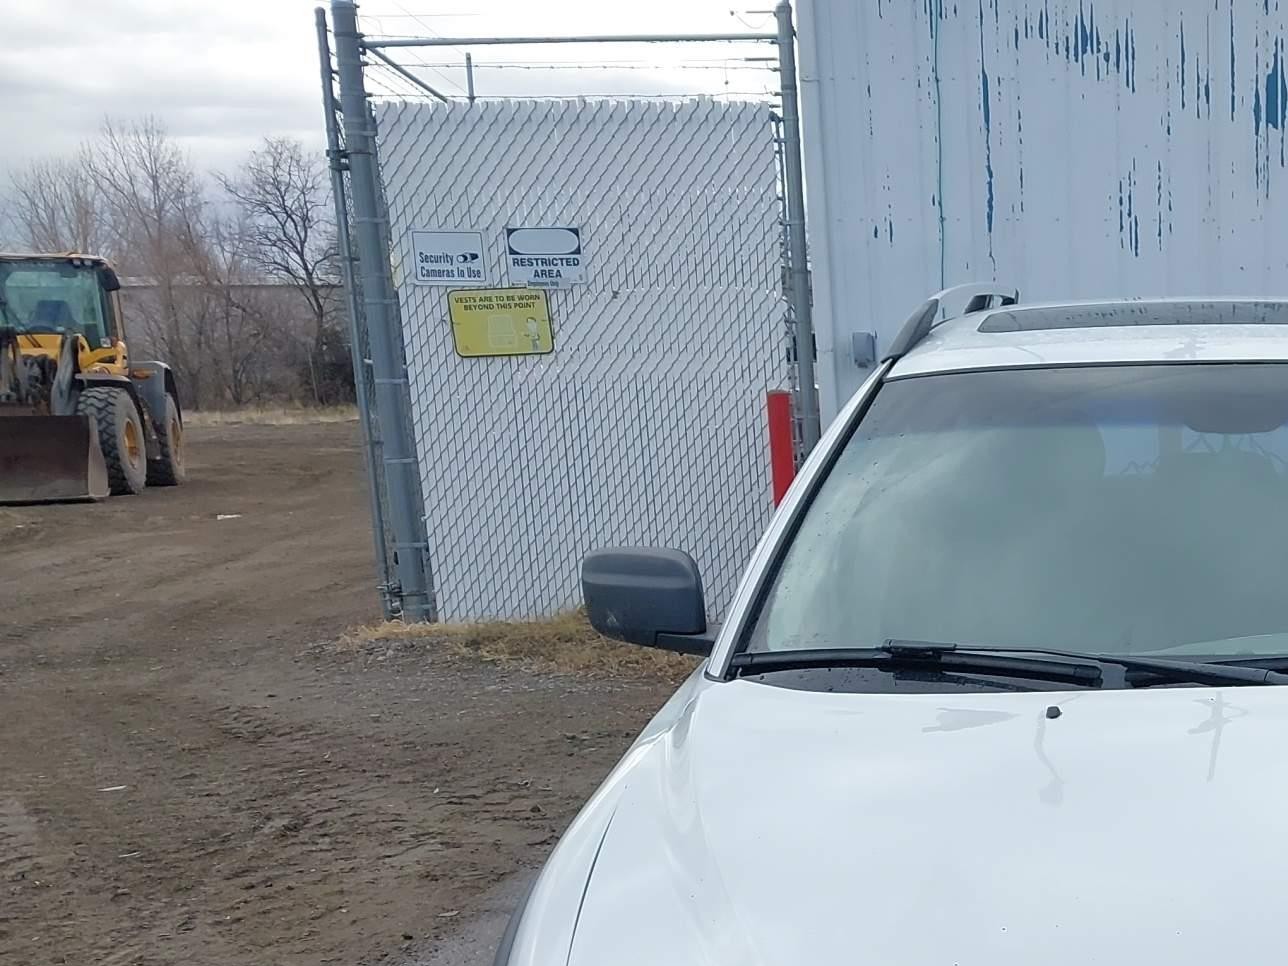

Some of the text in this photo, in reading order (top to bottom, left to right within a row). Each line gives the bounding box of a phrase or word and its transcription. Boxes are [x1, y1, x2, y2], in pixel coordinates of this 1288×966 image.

[419, 251, 454, 266] Security
[512, 257, 580, 267] RESTRICTED
[420, 266, 481, 278] Cameras In Use
[533, 269, 562, 279] AREA
[454, 296, 477, 304] VESTS
[478, 295, 494, 303] ARE
[463, 301, 536, 311] BEYOND THIS POINT
